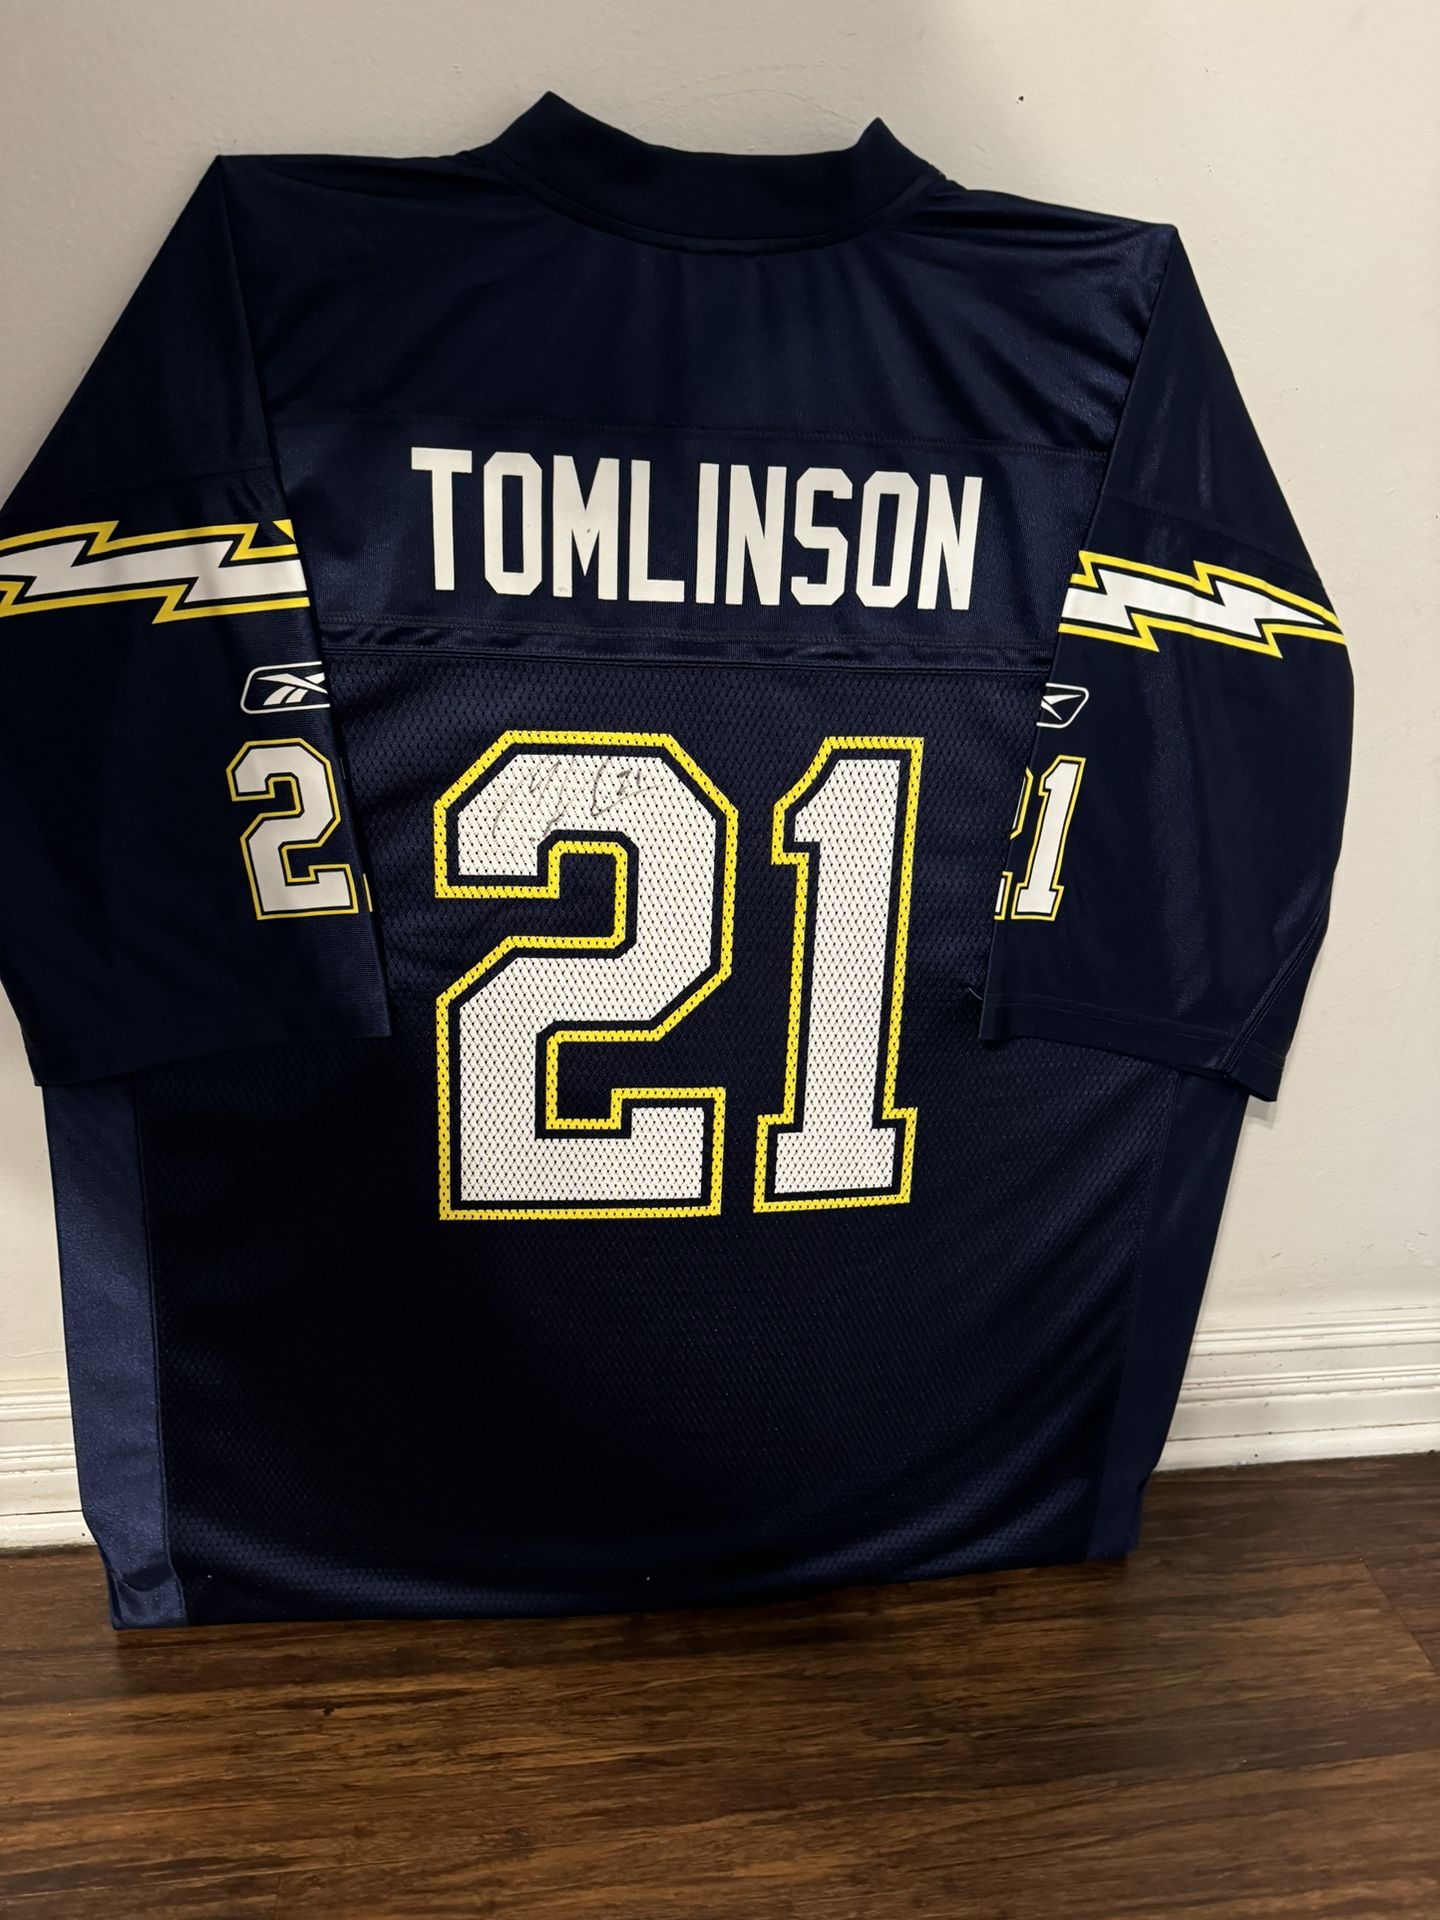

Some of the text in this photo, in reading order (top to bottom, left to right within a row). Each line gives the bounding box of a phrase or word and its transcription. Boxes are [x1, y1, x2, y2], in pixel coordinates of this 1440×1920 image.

[411, 447, 982, 610] TOMLINSON
[226, 737, 373, 920] 2
[994, 755, 1086, 921] 1
[434, 730, 924, 1220] 21
